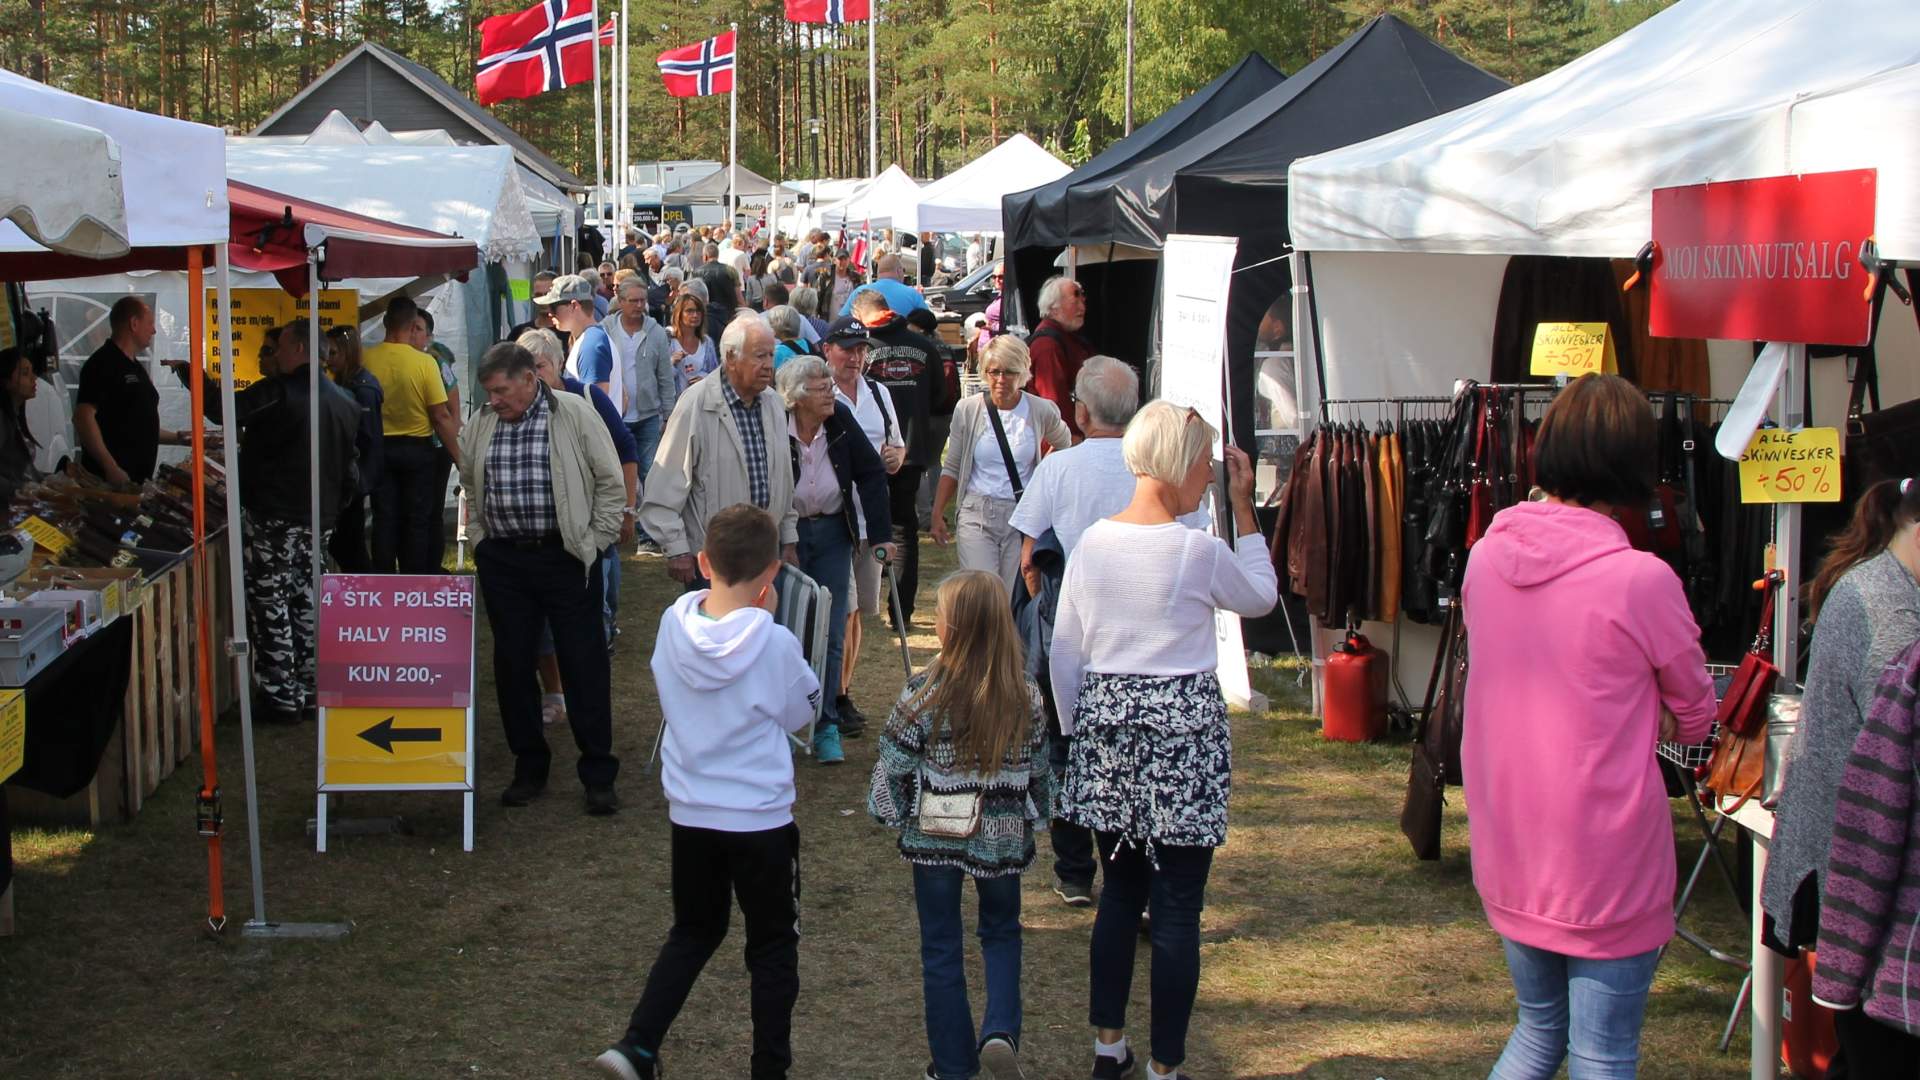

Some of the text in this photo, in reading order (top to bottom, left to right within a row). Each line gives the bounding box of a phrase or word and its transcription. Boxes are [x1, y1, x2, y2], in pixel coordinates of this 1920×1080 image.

[663, 210, 685, 221] OPEL
[1665, 240, 1852, 280] MOI SKINNUTSALG
[1759, 433, 1798, 444] ALLE
[321, 591, 472, 607] 4 STK PØLSER
[338, 627, 447, 642] HALV PRIS
[348, 666, 442, 685] KUN 200,-
